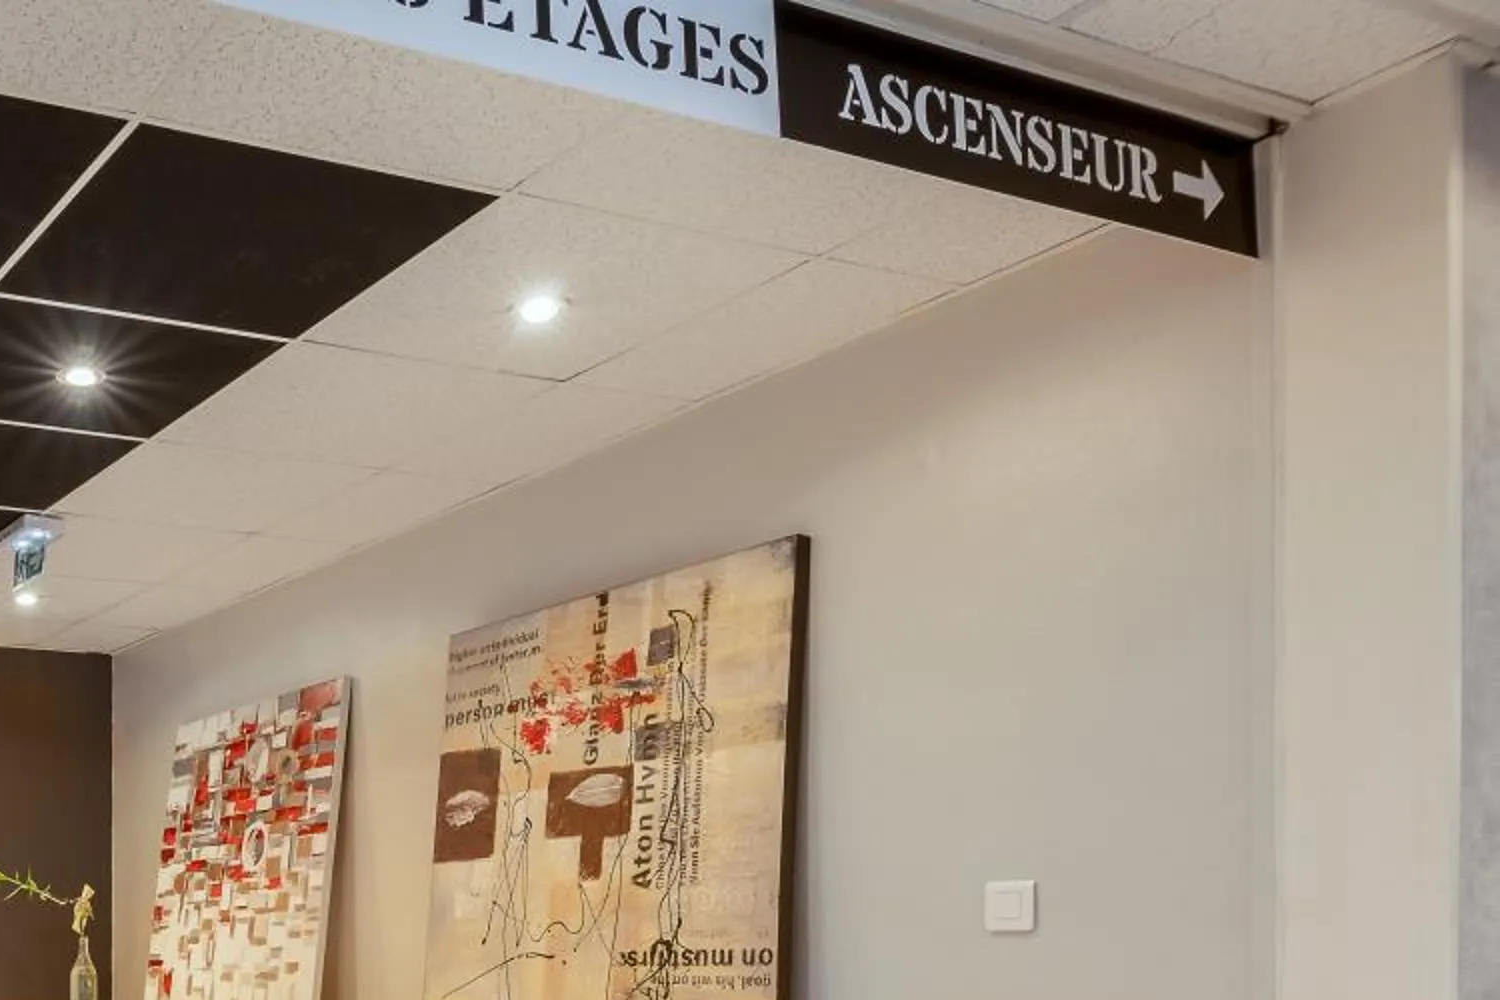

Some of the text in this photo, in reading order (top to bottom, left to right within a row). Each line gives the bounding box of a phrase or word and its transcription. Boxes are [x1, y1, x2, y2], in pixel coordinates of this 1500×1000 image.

[838, 63, 1163, 203] ASCENSEUR
[631, 814, 653, 889] Aton
[741, 947, 774, 967] on
